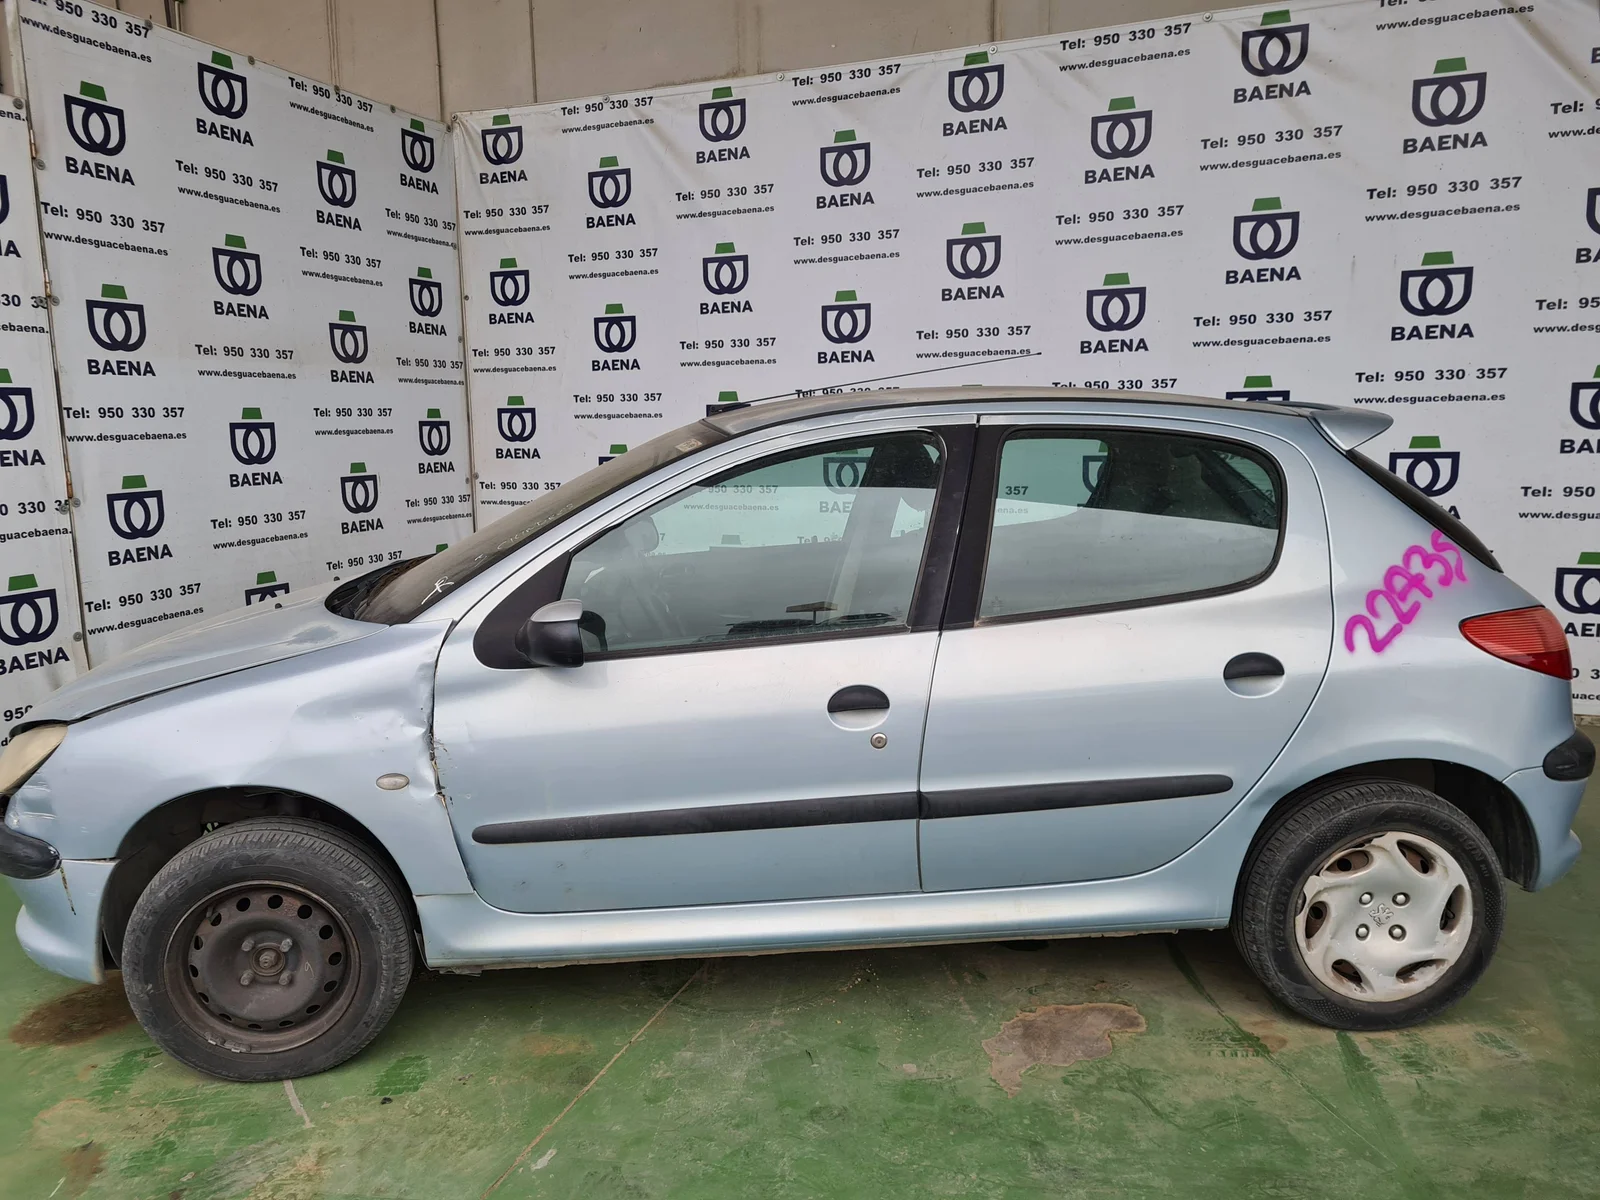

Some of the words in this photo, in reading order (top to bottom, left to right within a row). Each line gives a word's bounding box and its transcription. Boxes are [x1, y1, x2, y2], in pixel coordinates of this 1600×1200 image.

[1376, 4, 1535, 31] www.desguacebaena.es
[20, 15, 152, 63] www.desguacebaena.es
[1060, 38, 1086, 51] Tel:
[1093, 33, 1120, 46] 950
[1128, 28, 1155, 42] 330
[1164, 22, 1192, 37] 357
[1059, 49, 1190, 72] www.desguacebaena.es
[792, 75, 814, 87] Tel:
[820, 71, 842, 84] 950
[849, 67, 871, 80] 330
[878, 63, 901, 76] 357
[792, 87, 901, 106] www.desguacebaena.es
[1233, 80, 1311, 104] BAENA
[289, 101, 374, 133] www.desguacebaena.es
[196, 117, 254, 147] BAENA
[561, 118, 654, 134] www.desguacebaena.es
[943, 116, 1008, 137] BAENA
[1200, 137, 1228, 150] Tel:
[1237, 133, 1266, 146] 950
[1275, 129, 1304, 142] 330
[1313, 125, 1343, 138] 357
[1403, 131, 1488, 154] BAENA
[696, 146, 751, 164] BAENA
[1199, 152, 1341, 171] www.desguacebaena.es
[65, 156, 135, 186] BAENA
[175, 159, 198, 175] Tel:
[204, 166, 226, 181] 950
[232, 173, 253, 187] 330
[259, 179, 278, 192] 357
[916, 167, 940, 178] Tel:
[947, 164, 971, 176] 950
[978, 160, 1002, 172] 330
[1010, 157, 1035, 169] 357
[1084, 164, 1155, 184] BAENA
[400, 173, 439, 195] BAENA
[479, 169, 528, 184] BAENA
[916, 182, 1034, 198] www.desguacebaena.es
[1366, 187, 1397, 200] Tel:
[1406, 183, 1438, 197] 950
[1448, 179, 1479, 193] 330
[1490, 176, 1522, 190] 357
[177, 186, 281, 213] www.desguacebaena.es
[816, 191, 875, 209] BAENA
[40, 201, 68, 218] Tel:
[76, 208, 102, 223] 950
[110, 214, 135, 229] 330
[142, 219, 165, 233] 357
[316, 209, 362, 231] BAENA
[463, 210, 482, 219] Tel:
[485, 208, 504, 218] 950
[509, 206, 527, 217] 330
[531, 204, 549, 215] 357
[676, 206, 775, 220] www.desguacebaena.es
[1055, 214, 1080, 225] Tel:
[1088, 211, 1114, 223] 950
[1123, 208, 1149, 220] 330
[1157, 205, 1184, 217] 357
[1365, 204, 1520, 222] www.desguacebaena.es
[586, 213, 636, 229] BAENA
[464, 225, 551, 236] www.desguacebaena.es
[1055, 230, 1183, 246] www.desguacebaena.es
[43, 231, 169, 256] www.desguacebaena.es
[299, 246, 318, 259] Tel:
[322, 250, 340, 262] 950
[344, 254, 361, 266] 330
[365, 257, 381, 269] 357
[568, 253, 586, 263] Tel:
[591, 251, 610, 261] 950
[615, 249, 634, 260] 330
[639, 248, 658, 258] 357
[793, 252, 900, 265] www.desguacebaena.es
[301, 270, 383, 287] www.desguacebaena.es
[568, 269, 659, 280] www.desguacebaena.es
[1225, 266, 1302, 285] BAENA
[941, 285, 1005, 302] BAENA
[213, 300, 269, 320] BAENA
[700, 300, 753, 315] BAENA
[489, 311, 535, 325] BAENA
[1193, 316, 1220, 327] Tel:
[1229, 314, 1257, 326] 950
[1266, 312, 1294, 324] 330
[1303, 310, 1332, 322] 357
[409, 321, 447, 336] BAENA
[916, 330, 939, 340] Tel:
[946, 328, 969, 339] 950
[976, 327, 1000, 337] 330
[1007, 325, 1031, 336] 357
[1391, 323, 1474, 341] BAENA
[679, 341, 699, 350] Tel:
[704, 339, 724, 349] 950
[730, 338, 750, 348] 330
[756, 337, 776, 347] 357
[1080, 338, 1149, 354] BAENA
[1192, 336, 1331, 348] www.desguacebaena.es
[194, 344, 217, 356] Tel:
[223, 346, 244, 357] 950
[250, 347, 270, 359] 330
[275, 349, 294, 360] 357
[817, 349, 875, 364] BAENA
[916, 349, 1031, 359] www.desguacebaena.es
[87, 359, 156, 377] BAENA
[396, 357, 411, 366] Tel:
[414, 358, 429, 368] 950
[433, 359, 447, 369] 330
[450, 360, 464, 370] 357
[473, 365, 557, 374] www.desguacebaena.es
[592, 358, 641, 372] BAENA
[680, 358, 777, 368] www.desguacebaena.es
[197, 369, 297, 379] www.desguacebaena.es
[330, 369, 375, 384] BAENA
[398, 377, 465, 386] www.desguacebaena.es
[1355, 371, 1385, 383] Tel:
[1394, 370, 1425, 382] 950
[1434, 369, 1466, 381] 330
[1476, 367, 1508, 379] 357
[573, 394, 591, 403] Tel:
[596, 394, 615, 403] 950
[620, 393, 638, 402] 330
[644, 393, 662, 402] 357
[1353, 393, 1506, 405] www.desguacebaena.es
[63, 407, 90, 419] Tel:
[98, 407, 124, 419] 950
[131, 407, 156, 418] 330
[162, 407, 185, 418] 357
[574, 412, 663, 420] www.desguacebaena.es
[66, 432, 187, 443] www.desguacebaena.es
[314, 428, 394, 437] www.desguacebaena.es
[495, 448, 541, 459] BAENA
[418, 461, 455, 474] BAENA
[229, 471, 283, 488] BAENA
[1520, 486, 1552, 497] Tel:
[1563, 486, 1595, 497] 950
[405, 498, 420, 508] Tel:
[423, 497, 438, 506] 950
[441, 495, 455, 505] 330
[458, 494, 471, 503] 357
[210, 518, 232, 529] Tel:
[237, 515, 258, 527] 950
[263, 512, 283, 524] 330
[288, 510, 306, 521] 357
[341, 518, 384, 535] BAENA
[407, 512, 472, 524] www.desguacebaena.es
[213, 532, 308, 550] www.desguacebaena.es
[108, 544, 173, 566] BAENA
[84, 599, 111, 613] Tel:
[118, 593, 143, 607] 950
[150, 587, 173, 601] 330
[179, 582, 201, 596] 357
[87, 607, 204, 636] www.desguacebaena.es
